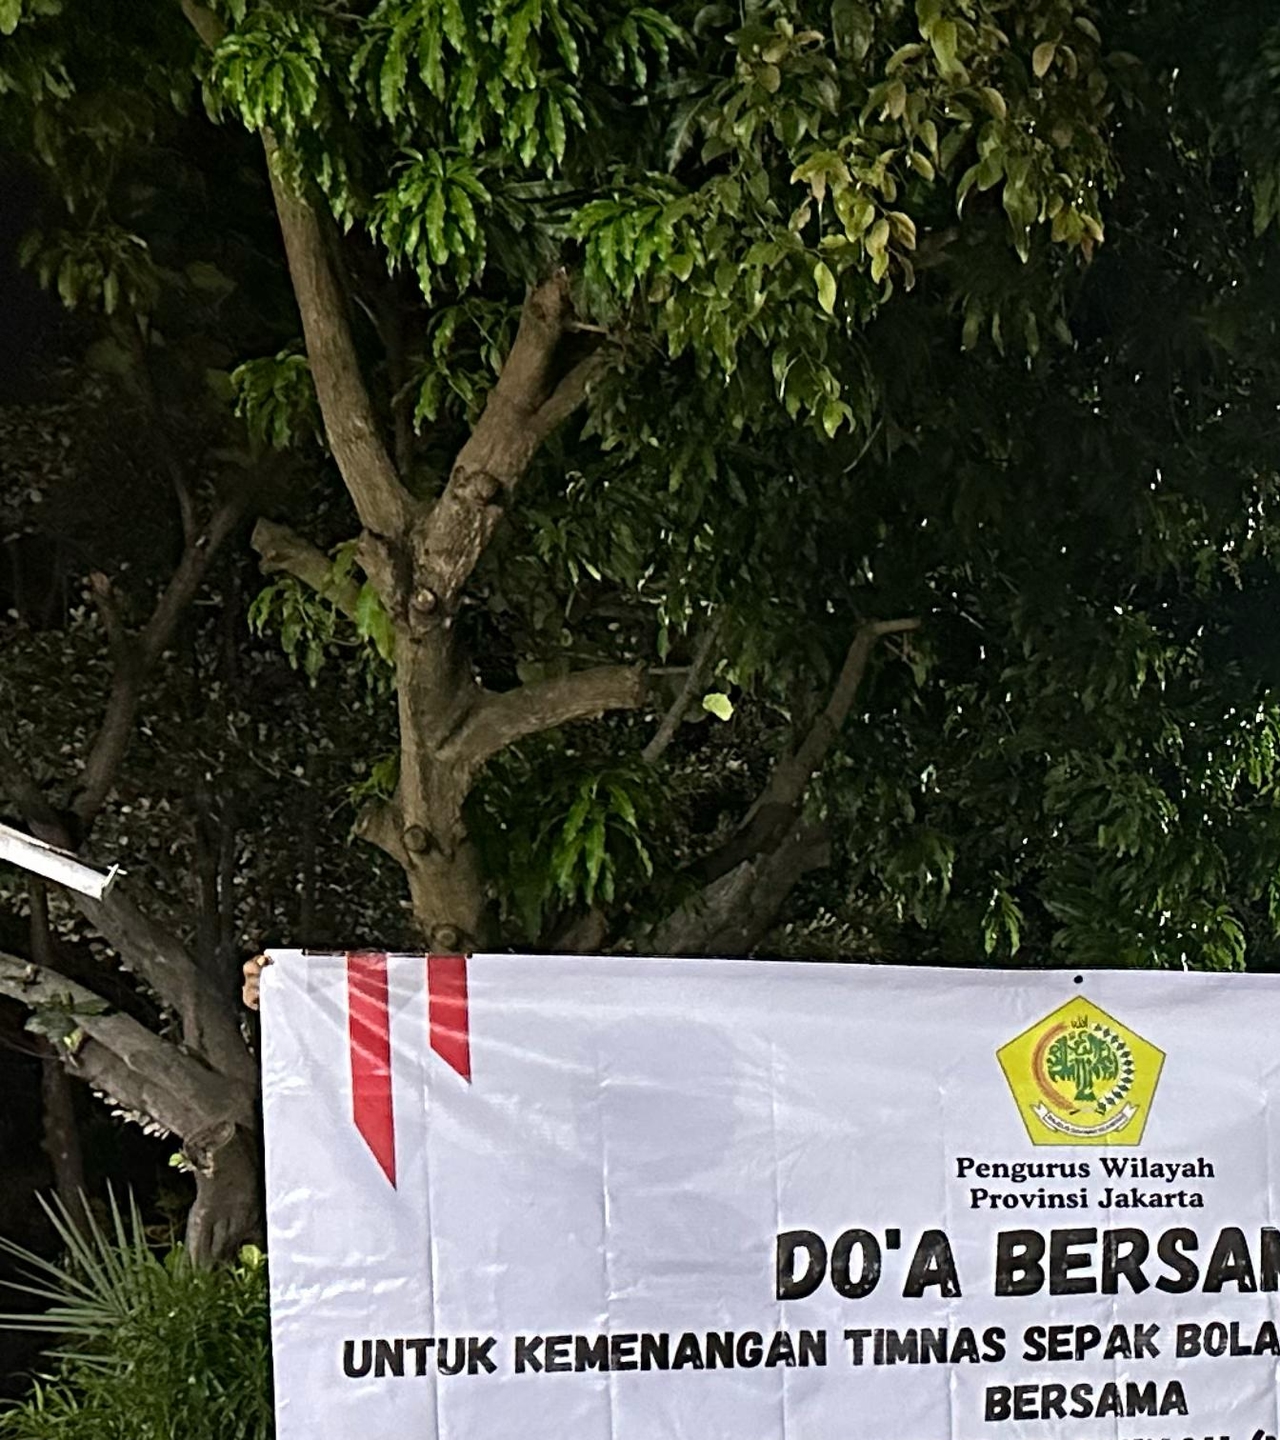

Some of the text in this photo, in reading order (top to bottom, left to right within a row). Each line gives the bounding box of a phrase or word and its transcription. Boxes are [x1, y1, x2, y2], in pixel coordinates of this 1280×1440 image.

[957, 1158, 1214, 1183] Pengurus Wilayah
[970, 1188, 1204, 1208] Provinsi Jakarta
[776, 1229, 962, 1301] DO'A
[344, 1337, 497, 1378] UNTUK
[515, 1330, 826, 1373] KEMENANGAN
[844, 1327, 1006, 1366] TIMNAS
[1023, 1324, 1160, 1361] SEPAK
[985, 1381, 1189, 1421] BERSAMA
